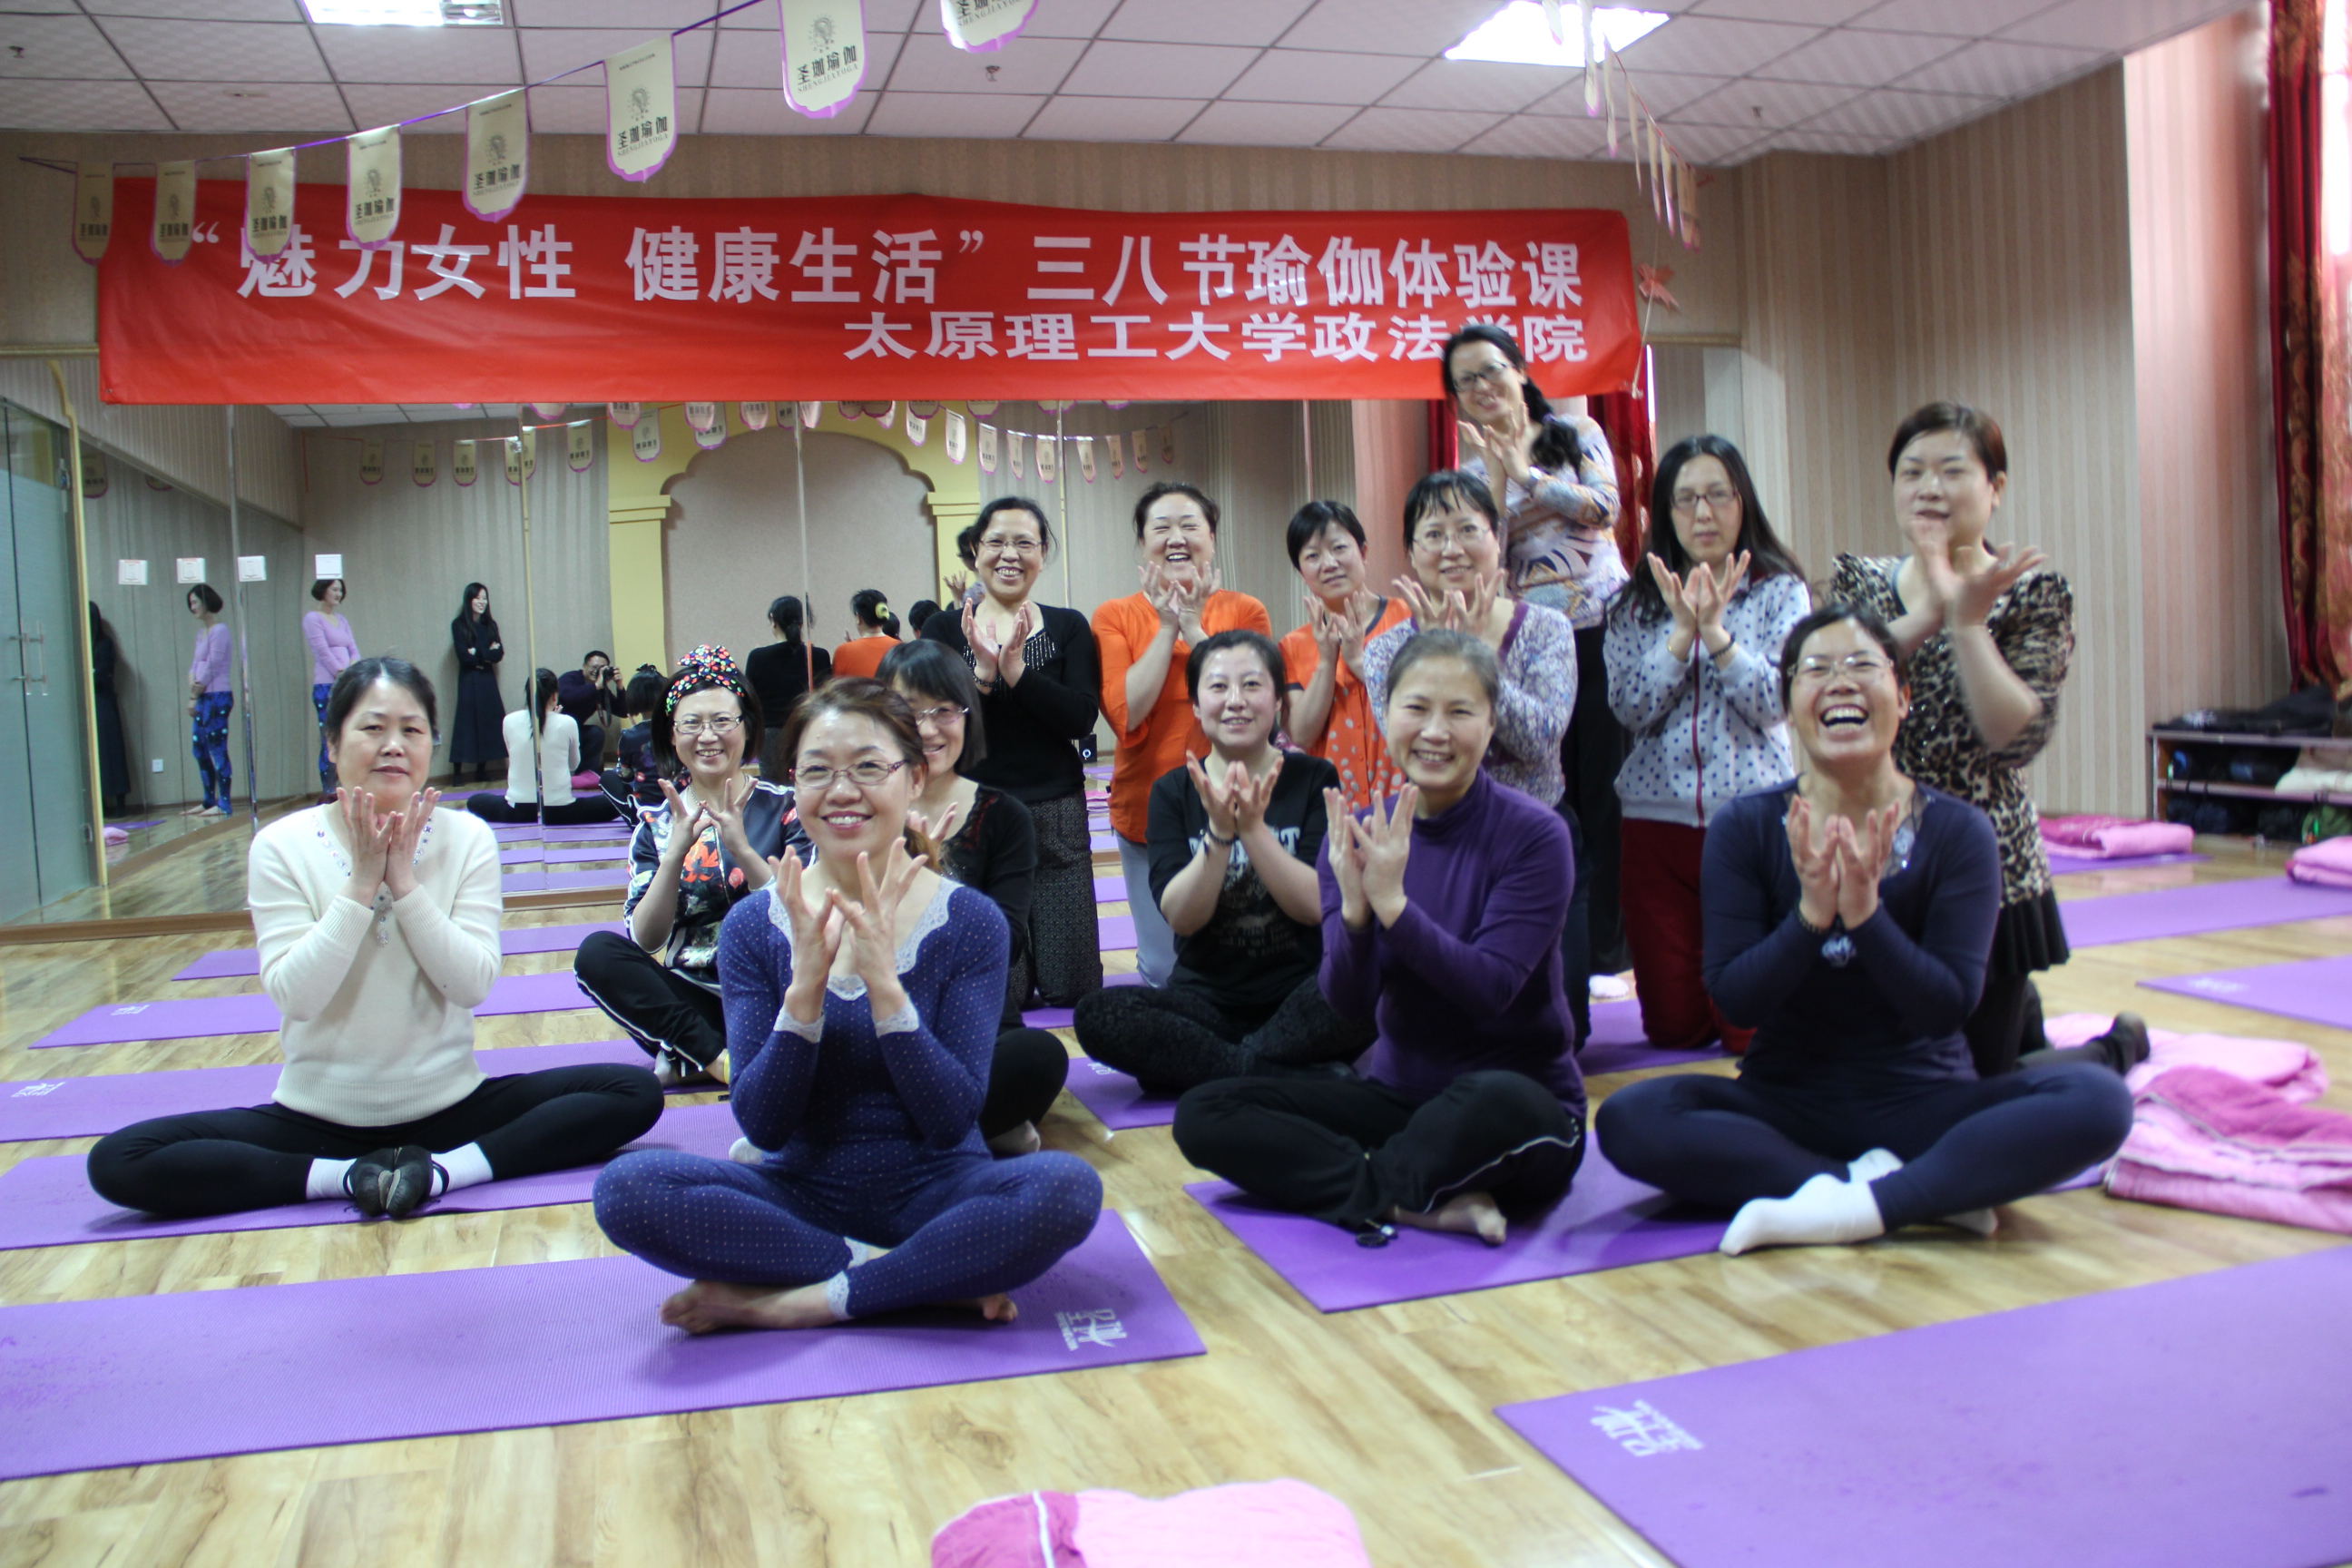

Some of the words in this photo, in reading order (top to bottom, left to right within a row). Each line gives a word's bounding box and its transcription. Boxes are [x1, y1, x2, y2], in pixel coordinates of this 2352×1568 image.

[625, 226, 984, 304] 健康生活”
[1027, 233, 1583, 309] 三八节瑜伽体验课
